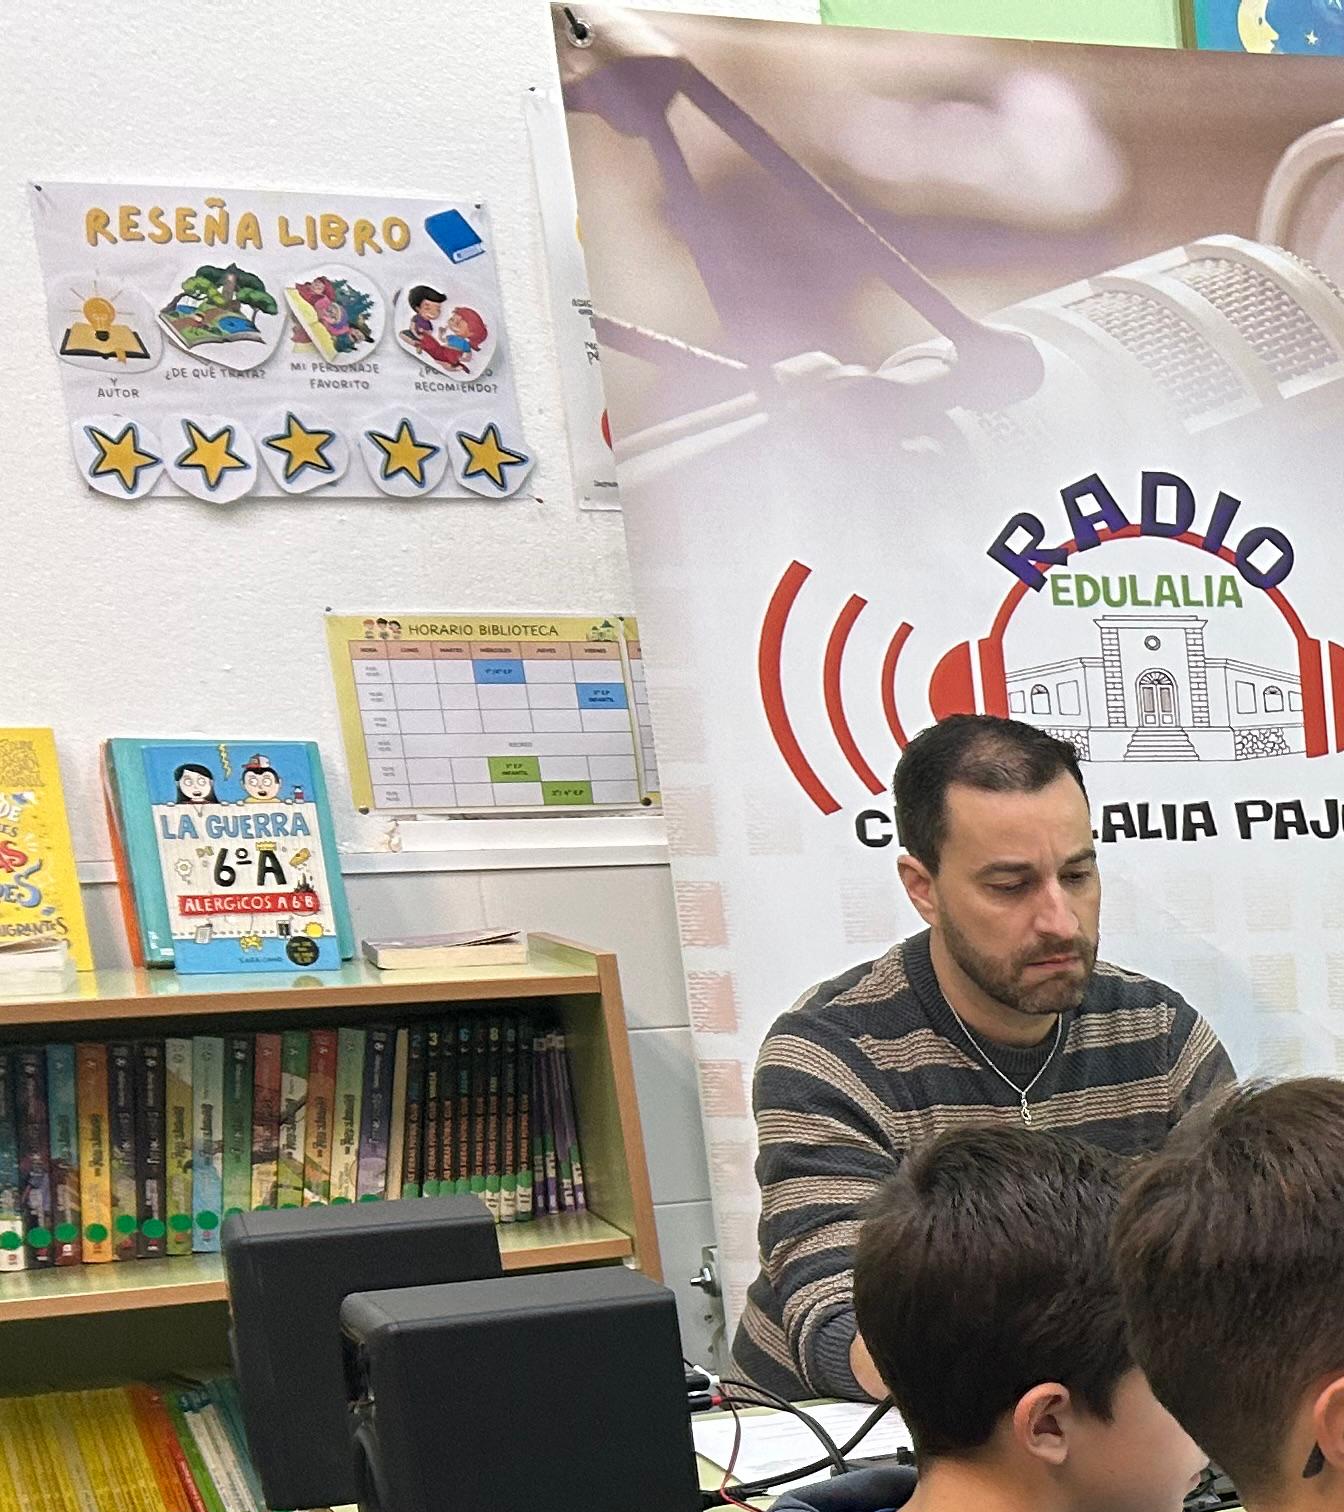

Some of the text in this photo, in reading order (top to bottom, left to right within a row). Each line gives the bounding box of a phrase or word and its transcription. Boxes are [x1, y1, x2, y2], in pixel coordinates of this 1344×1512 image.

[85, 197, 411, 257] RESEÑA LIBRO
[309, 378, 369, 390] FAVORITO
[415, 381, 498, 394] RECOMIENDO?
[98, 387, 140, 398] AUTOR
[986, 471, 1294, 592] RADIO
[1050, 573, 1244, 609] EDULALIA
[408, 624, 559, 636] HORARIO BIBLIOTECA
[160, 812, 311, 840] LA GUERRA
[428, 1033, 438, 1047] 3
